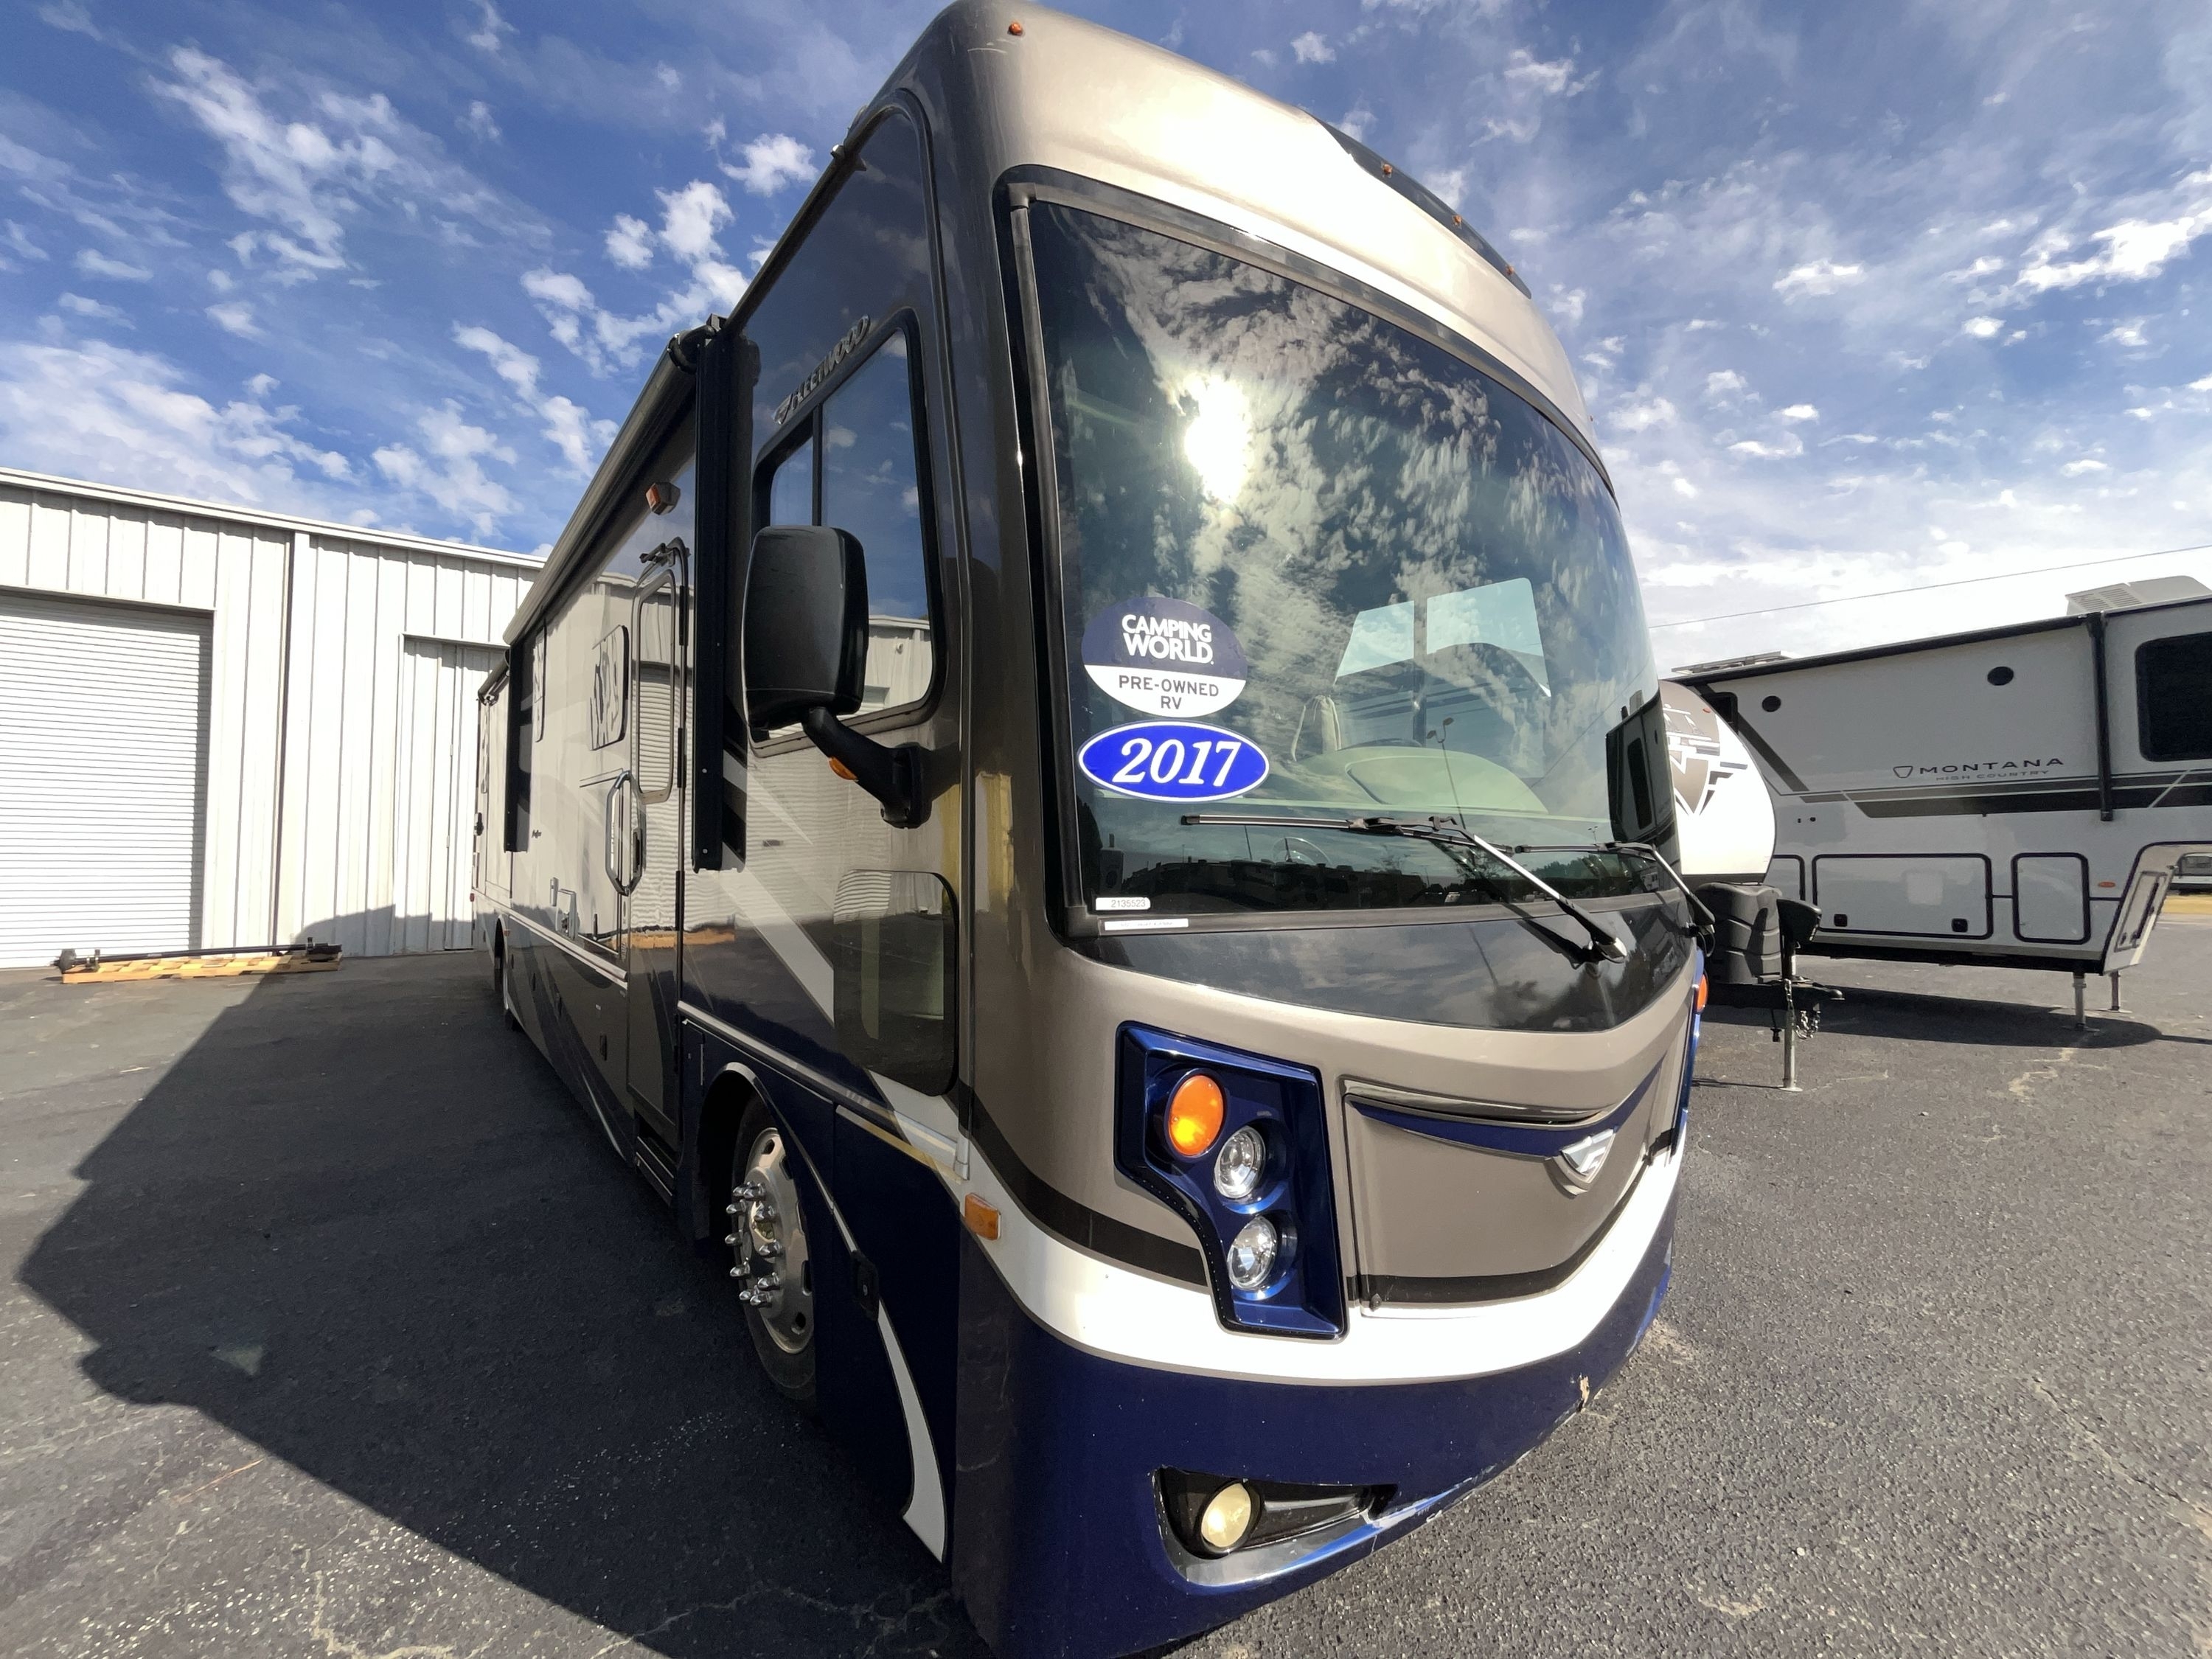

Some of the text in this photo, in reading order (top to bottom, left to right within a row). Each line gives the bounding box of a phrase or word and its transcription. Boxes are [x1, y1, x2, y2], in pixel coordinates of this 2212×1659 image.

[1121, 614, 1212, 643] CAMPING
[1122, 632, 1213, 664] WORLD
[1119, 675, 1219, 697] PRE-OWNED
[1161, 695, 1182, 710] RV
[1111, 737, 1242, 787] 2017
[1919, 758, 2064, 774] MONTANA
[1976, 770, 2050, 780] COUNTRY
[1110, 899, 1146, 908] 2135523
